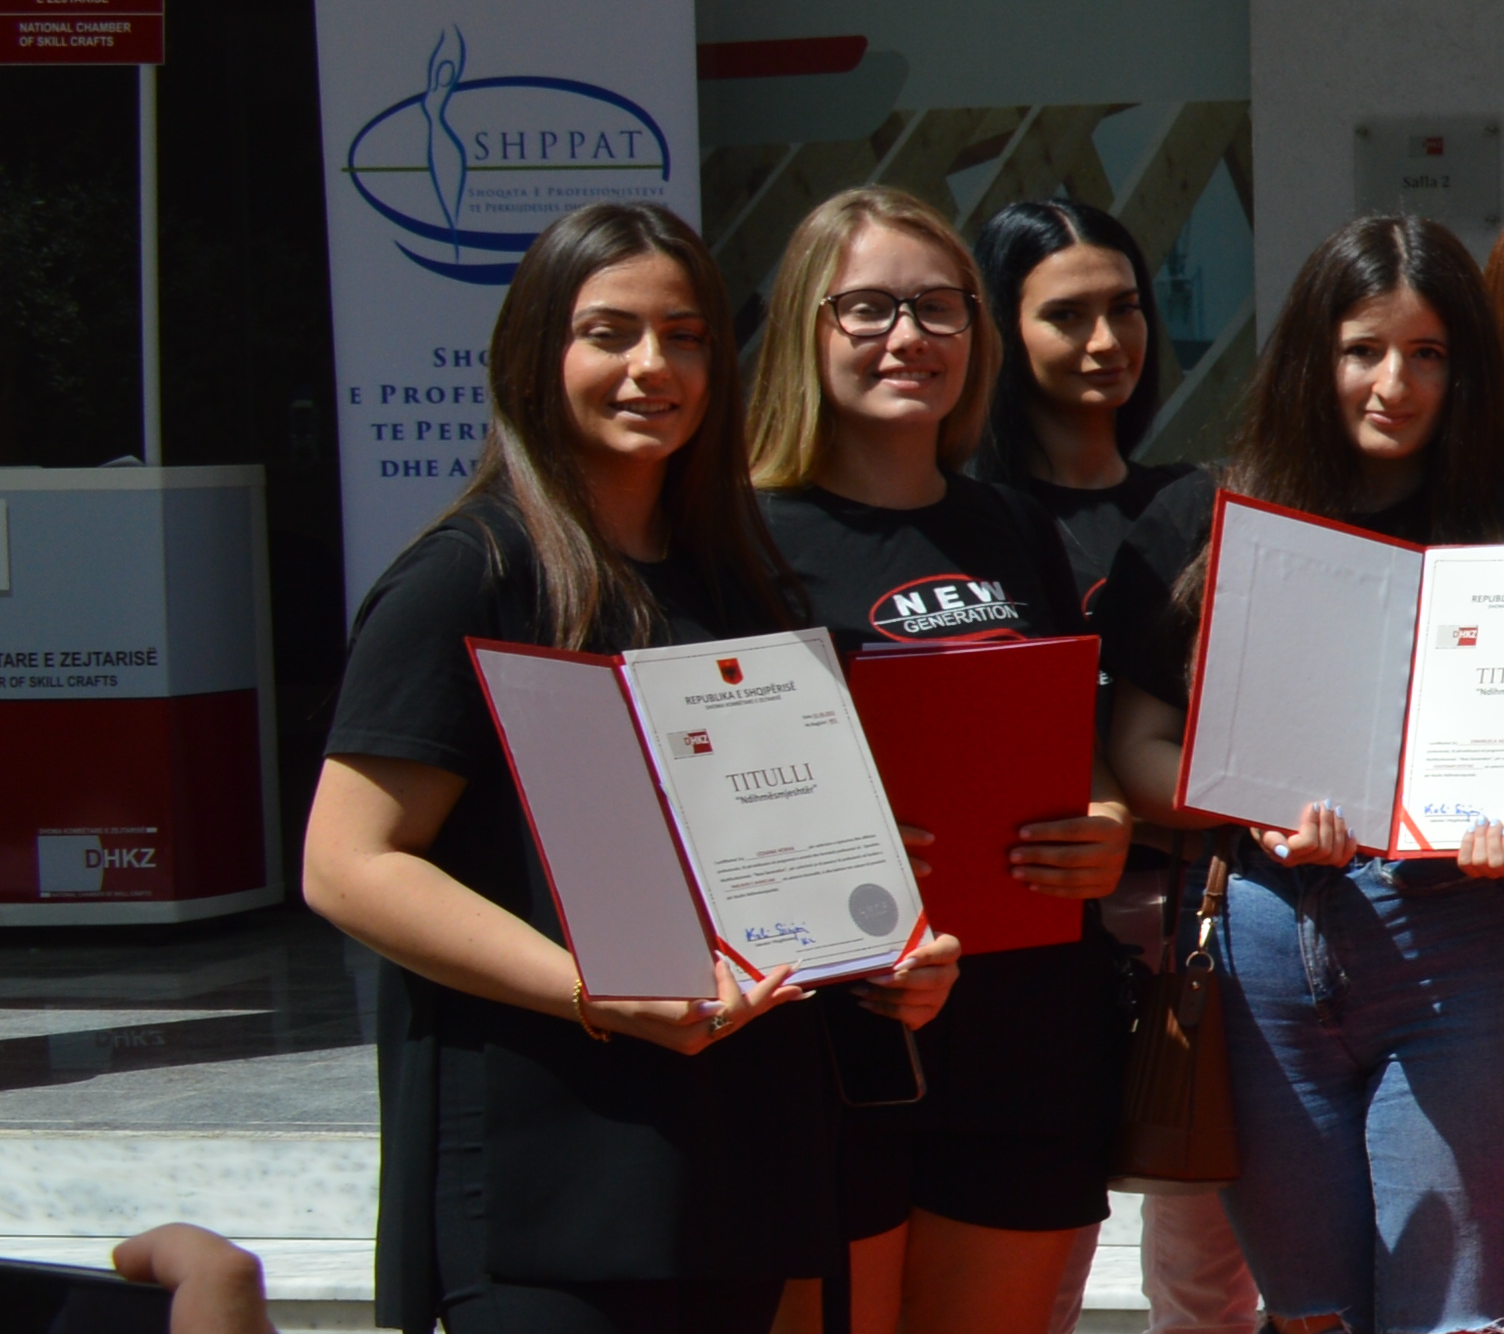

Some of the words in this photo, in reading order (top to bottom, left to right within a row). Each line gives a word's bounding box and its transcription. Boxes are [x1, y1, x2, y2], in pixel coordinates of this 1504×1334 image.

[19, 22, 74, 33] NATIONAL
[75, 22, 132, 33] CHAMBER
[19, 36, 33, 47] OF
[36, 36, 67, 47] SKILL
[70, 35, 115, 47] CRAFTS
[474, 130, 644, 162] SHPPAT
[1402, 175, 1438, 189] Salla
[1440, 175, 1450, 188] 2
[349, 386, 362, 405] E
[379, 384, 485, 405] PROFE
[371, 423, 405, 441] TE
[381, 459, 439, 477] DHE
[892, 581, 1006, 617] NEW
[903, 604, 1019, 634] GENERATION
[44, 652, 55, 668] E
[60, 646, 158, 668] ZEJTARISË
[9, 676, 26, 688] OF
[29, 675, 64, 688] SKILL
[67, 674, 118, 687] CRAFTS
[684, 691, 735, 706] REPUBLIKA
[743, 680, 798, 699] SHQIPËRISË
[726, 762, 815, 793] TITULLI
[85, 847, 157, 869] DHKZ
